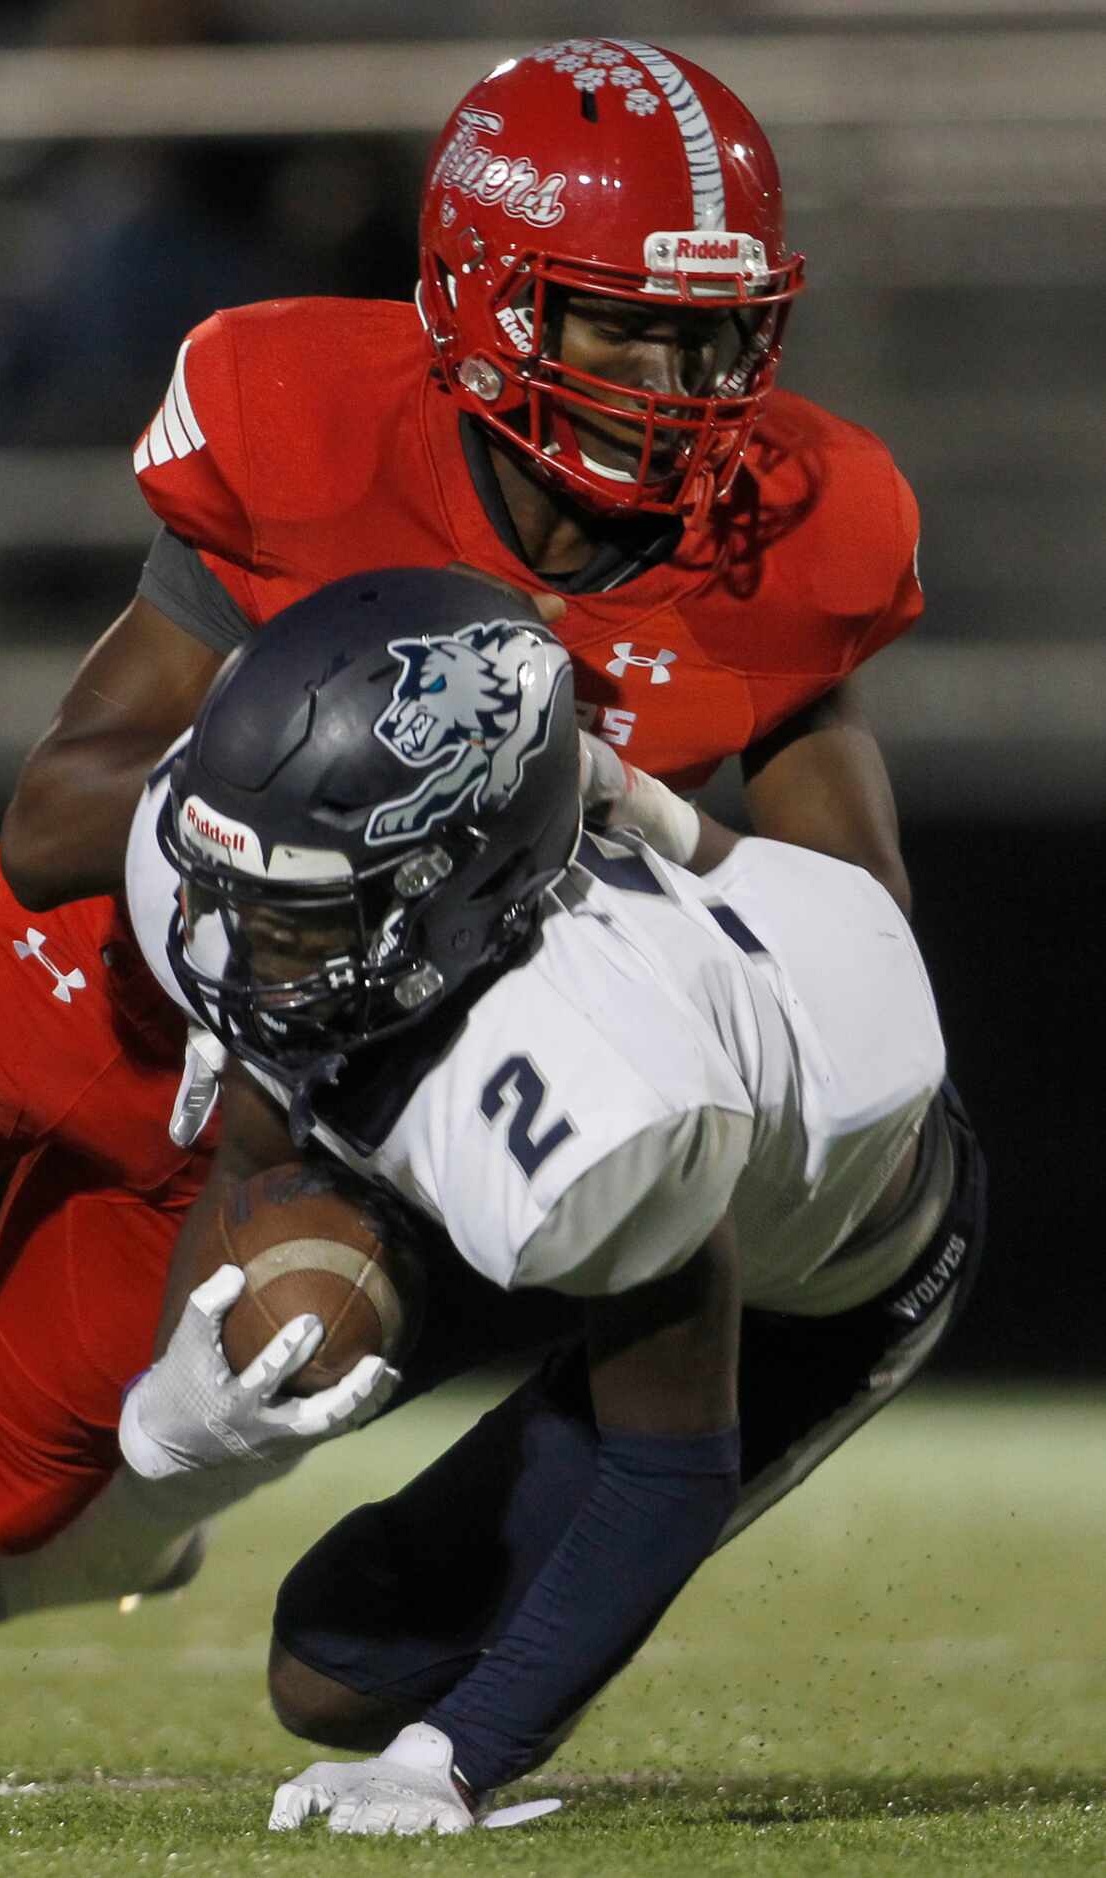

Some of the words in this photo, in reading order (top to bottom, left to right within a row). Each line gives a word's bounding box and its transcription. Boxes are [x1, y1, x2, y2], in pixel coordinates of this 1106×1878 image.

[432, 104, 567, 228] Tigers
[676, 238, 738, 259] Riddell
[187, 804, 246, 853] Riddell
[476, 1051, 580, 1186] 2
[893, 1233, 966, 1319] WOLVES
